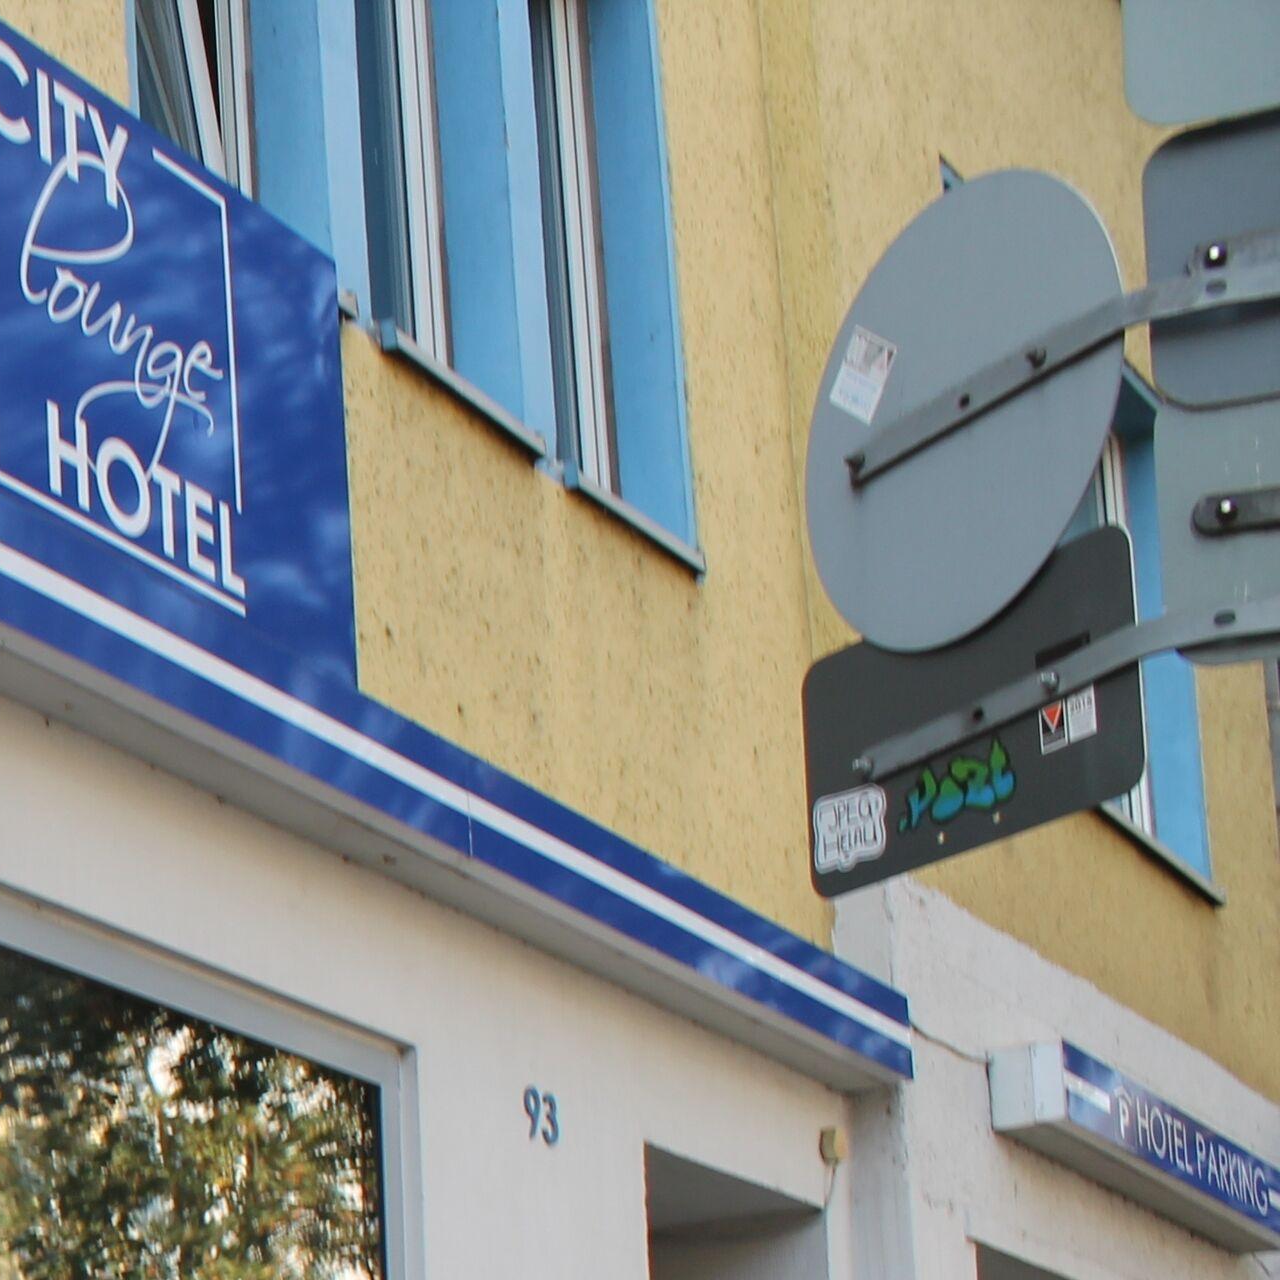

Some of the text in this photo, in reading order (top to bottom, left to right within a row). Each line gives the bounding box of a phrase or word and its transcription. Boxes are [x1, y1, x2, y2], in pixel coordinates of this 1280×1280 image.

[46, 400, 247, 600] HOTEL
[524, 1086, 559, 1147] 93
[1136, 1095, 1193, 1176] HOTEL
[1196, 1131, 1269, 1217] PARKING
